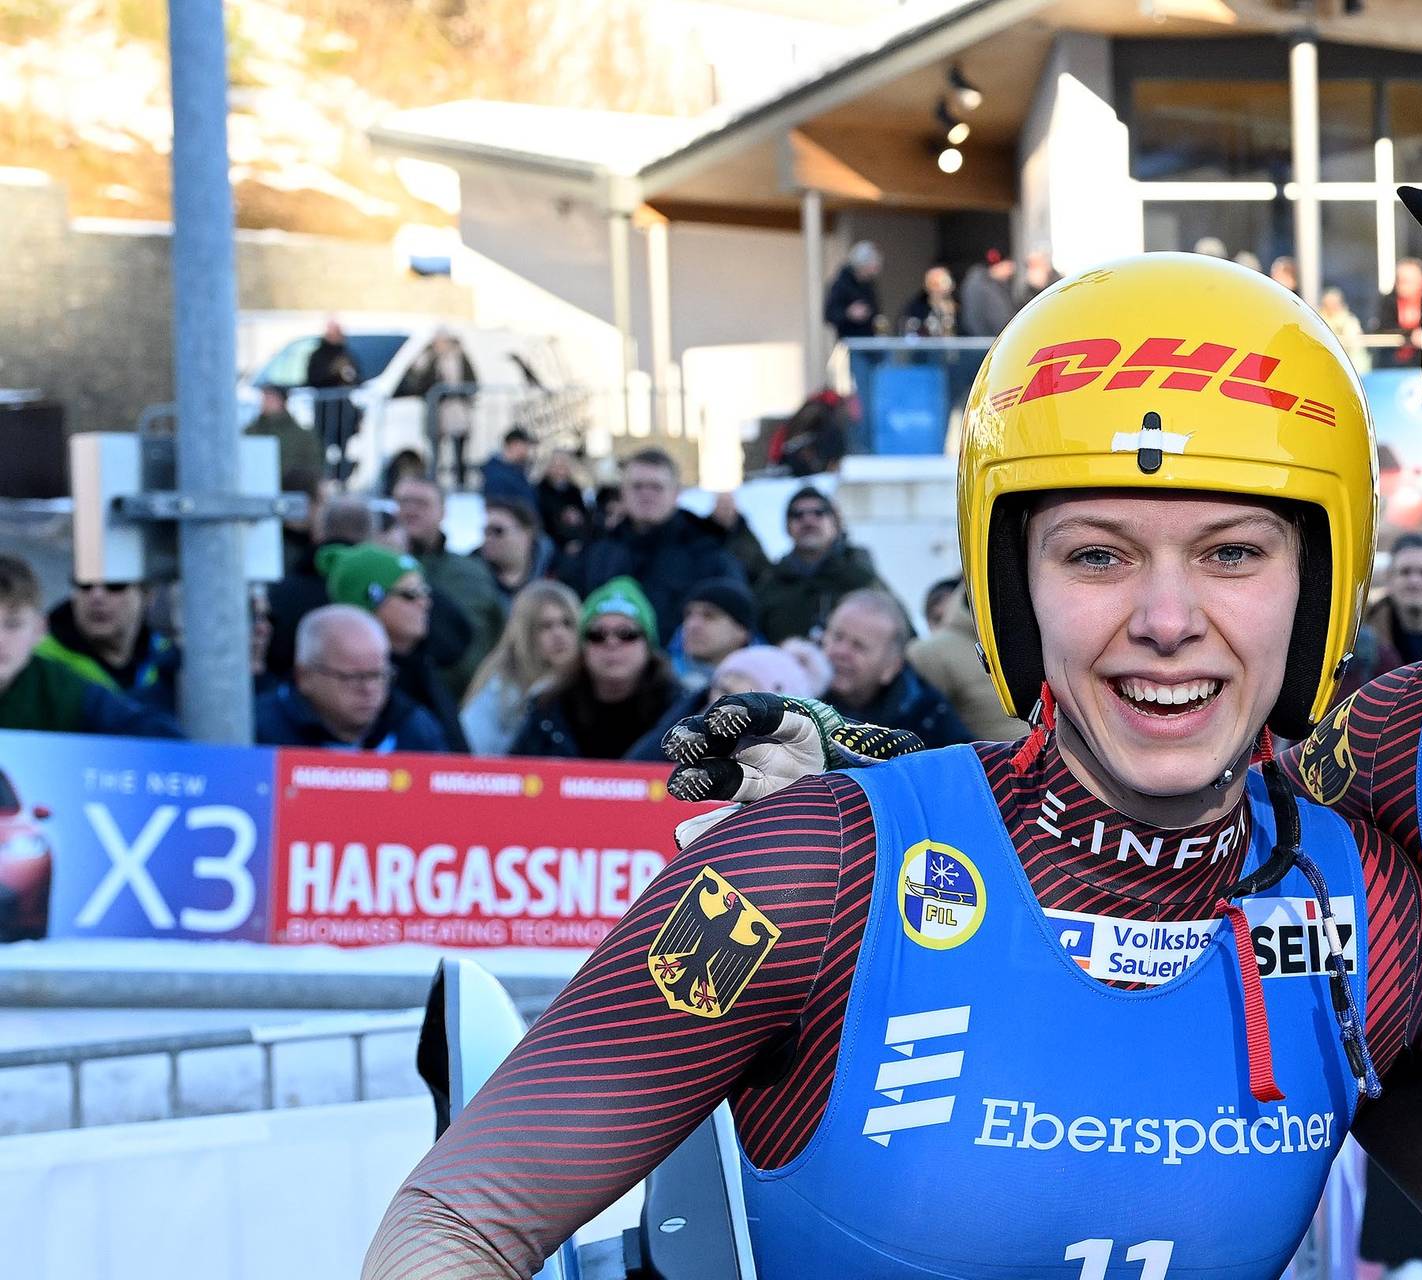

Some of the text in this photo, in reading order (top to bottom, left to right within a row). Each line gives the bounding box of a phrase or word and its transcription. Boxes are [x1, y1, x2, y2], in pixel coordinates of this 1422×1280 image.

[1018, 337, 1299, 412] DHL
[74, 801, 258, 933] X3
[926, 904, 958, 927] FIL
[974, 1097, 1335, 1165] Eberspächer
